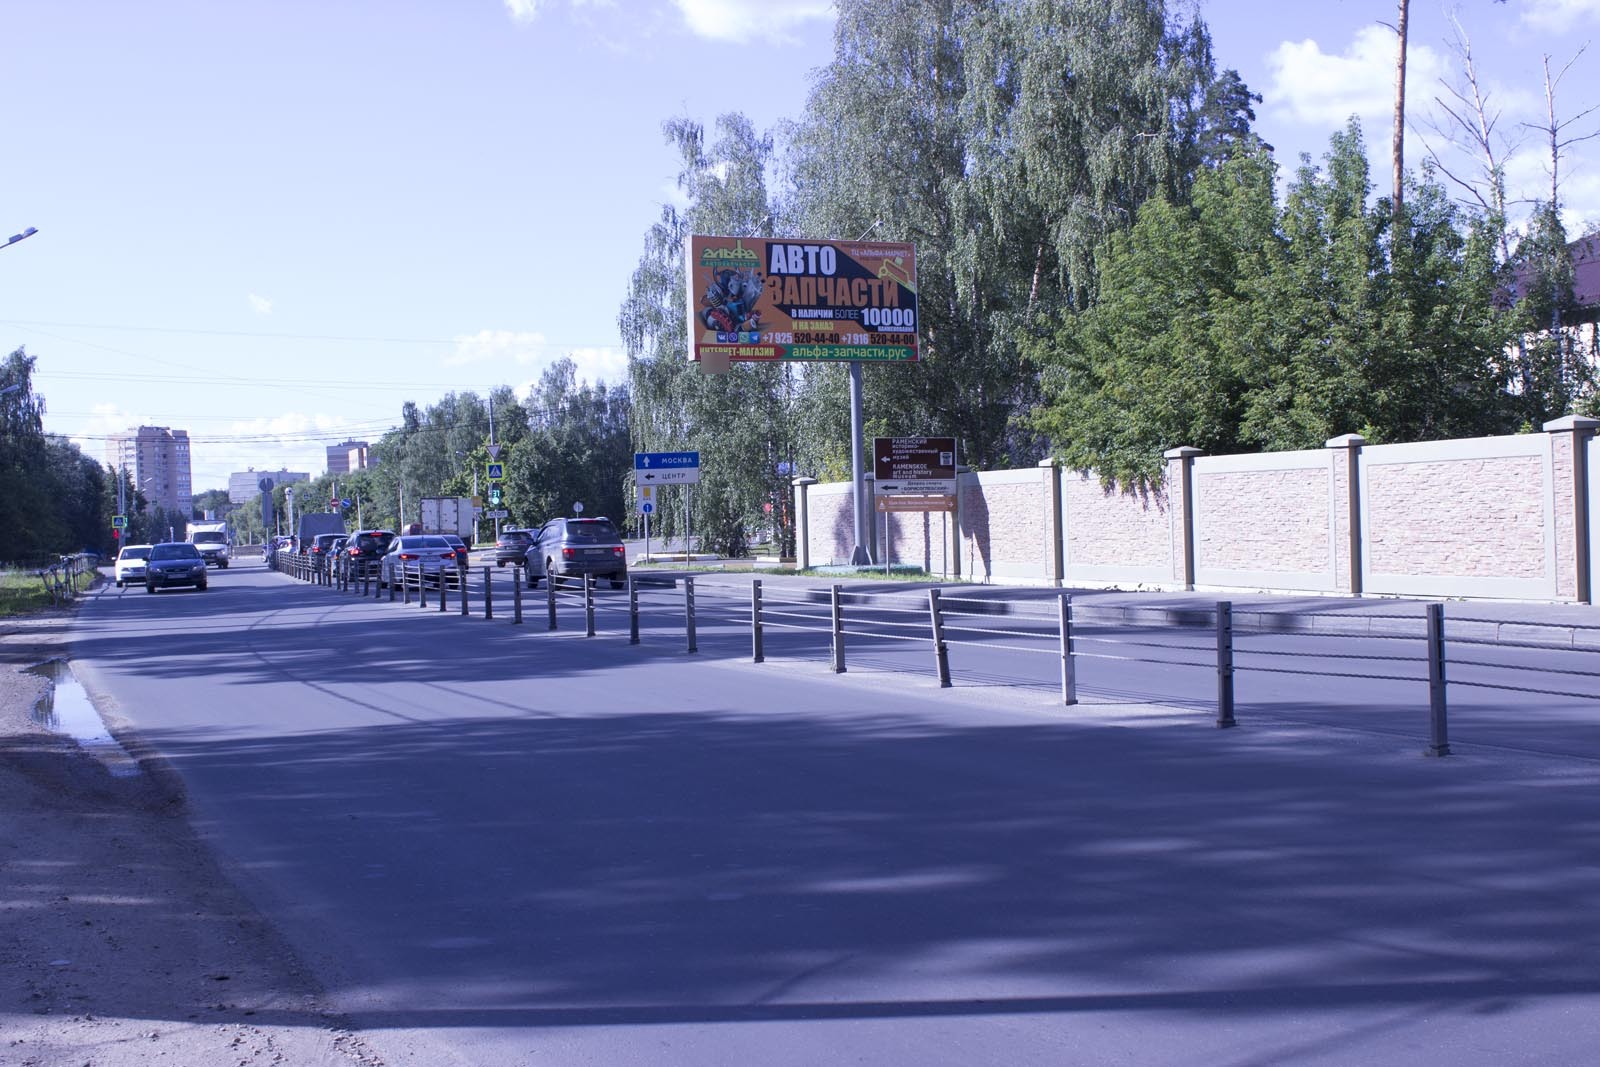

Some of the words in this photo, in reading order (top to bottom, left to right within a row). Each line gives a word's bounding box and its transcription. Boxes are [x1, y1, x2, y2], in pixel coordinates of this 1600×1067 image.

[770, 243, 837, 275] АВТО
[767, 275, 899, 307] ЗАПЧАСТИ
[791, 308, 797, 318] В
[798, 309, 833, 318] НАЛИЧИИ
[834, 309, 859, 319] БОЛЕЕ
[861, 307, 914, 326] 10000
[792, 320, 797, 330] И
[799, 320, 809, 330] НА
[810, 321, 834, 331] ЗАКАЗ
[762, 332, 773, 344] +7
[775, 332, 793, 344] 925
[794, 332, 839, 345] 520-44-40
[853, 333, 869, 345] 916
[870, 334, 915, 345] 520-44-00
[792, 345, 907, 361] альфа-запчасти.рус
